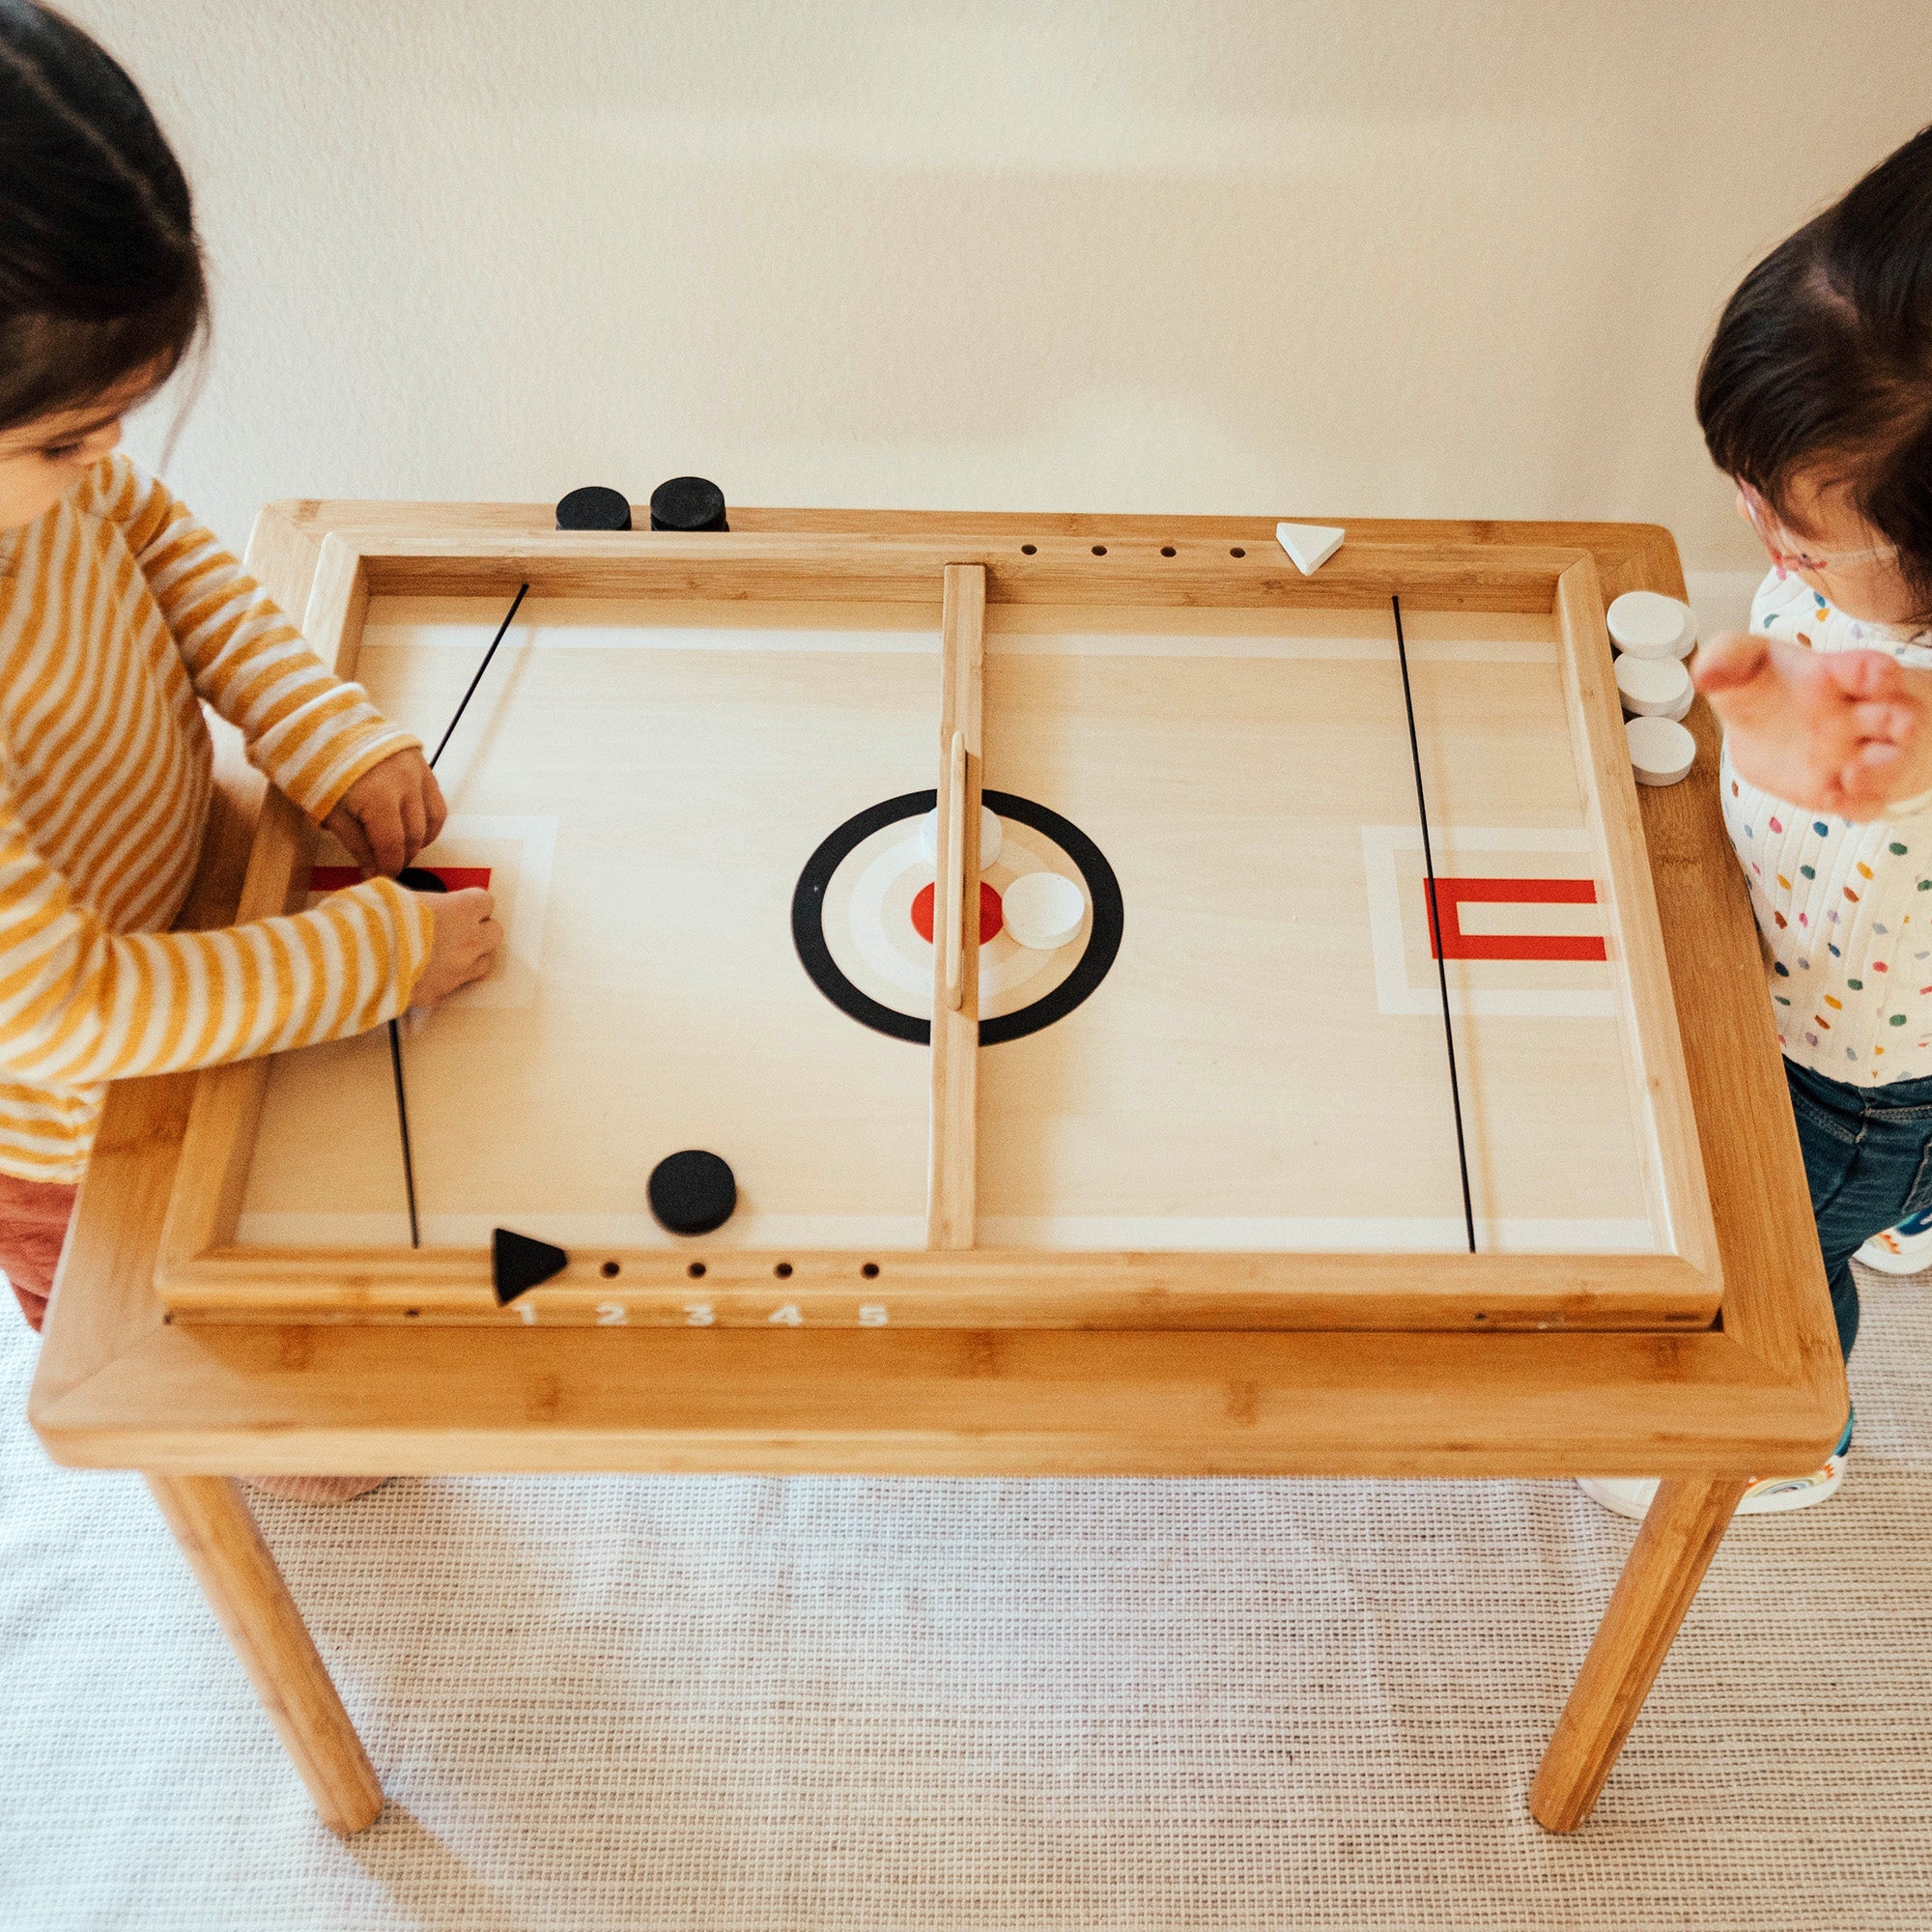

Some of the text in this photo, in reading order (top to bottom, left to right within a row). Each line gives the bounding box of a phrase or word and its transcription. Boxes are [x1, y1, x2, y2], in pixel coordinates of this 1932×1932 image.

[512, 1303, 889, 1326] 1 2 3 4 5
